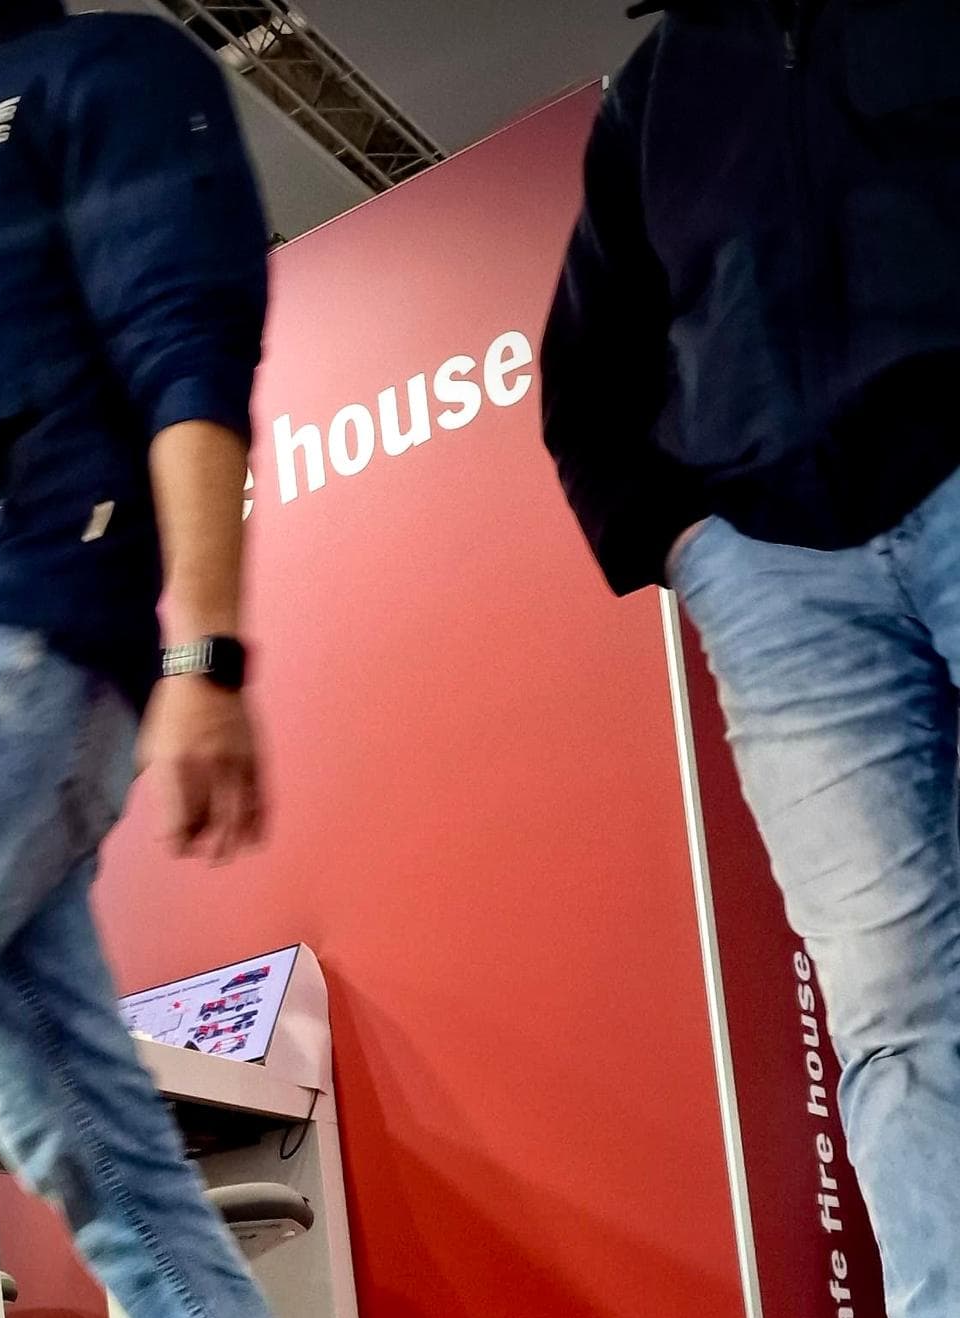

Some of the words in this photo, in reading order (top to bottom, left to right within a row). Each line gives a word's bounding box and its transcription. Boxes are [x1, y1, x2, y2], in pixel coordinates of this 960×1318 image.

[271, 330, 534, 506] house
[794, 951, 829, 1117] house
[817, 1133, 844, 1233] fire
